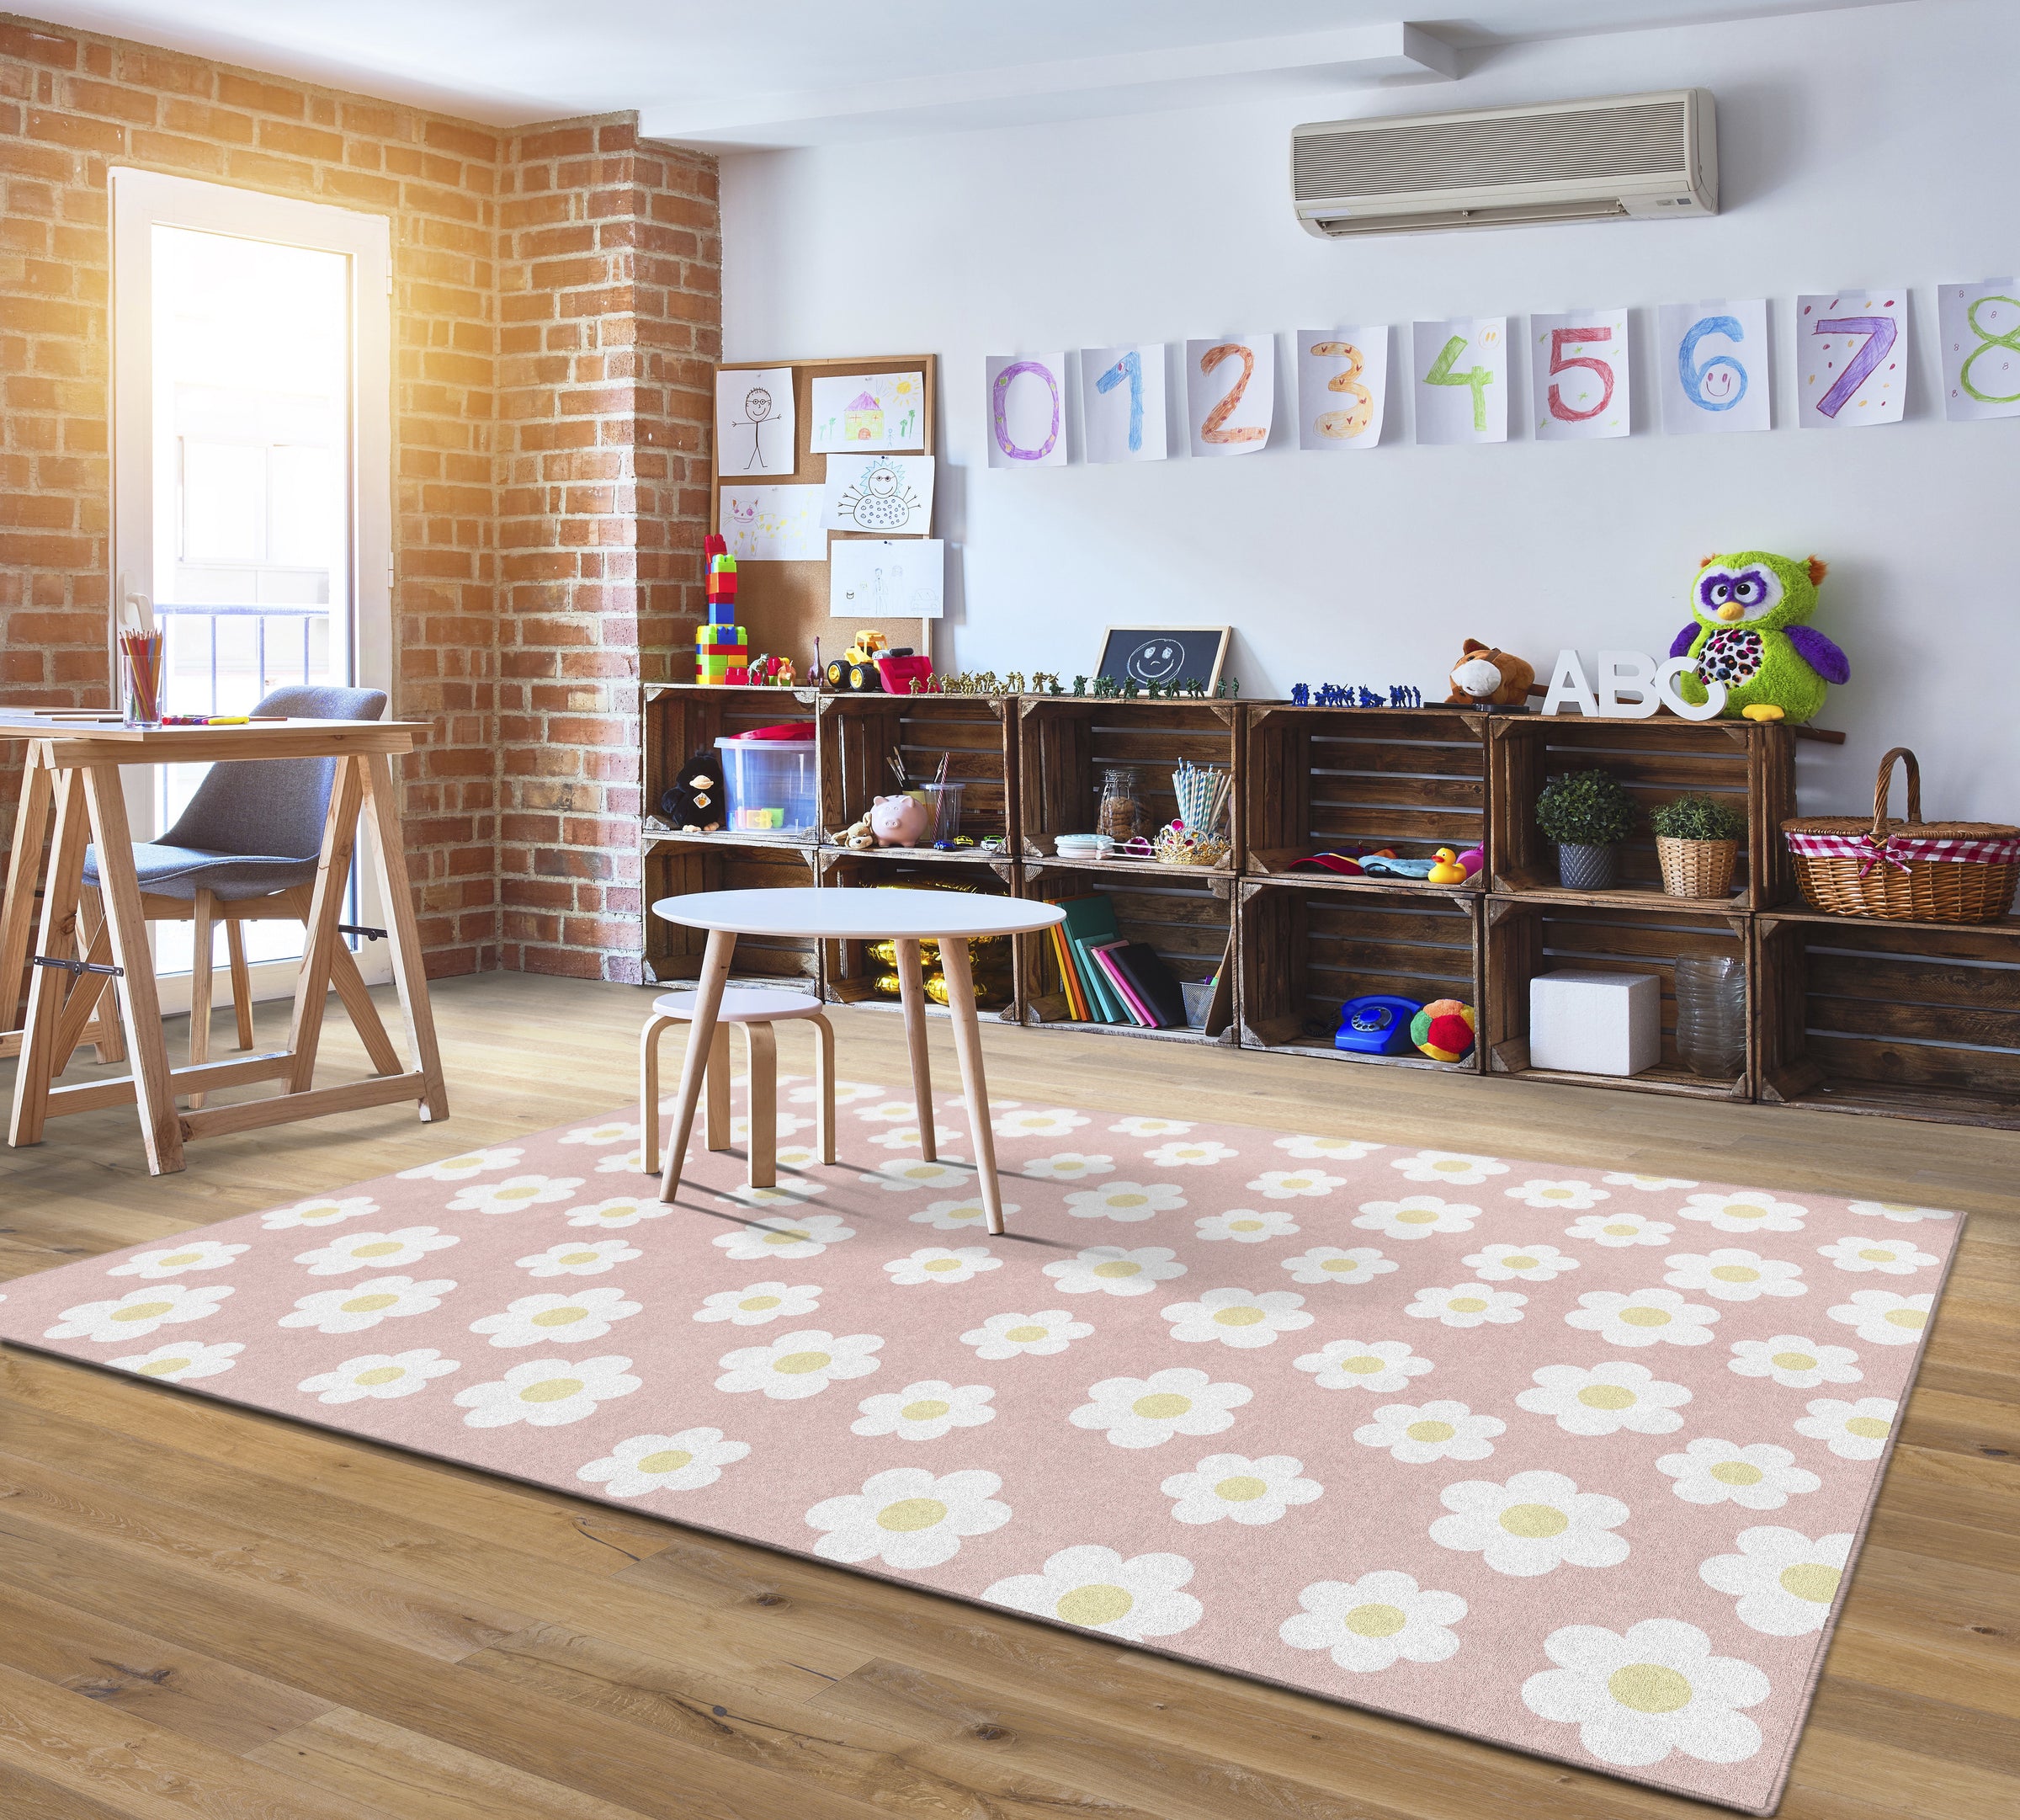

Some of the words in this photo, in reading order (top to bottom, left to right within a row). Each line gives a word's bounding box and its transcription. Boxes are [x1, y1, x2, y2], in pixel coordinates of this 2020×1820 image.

[1200, 343, 1267, 444] 2
[1310, 341, 1374, 439] 3
[1422, 335, 1493, 431] 4
[1548, 327, 1614, 423] 5
[1678, 316, 1748, 411] 6
[1812, 317, 1897, 418] 7
[1960, 295, 2020, 404] 8
[993, 361, 1059, 460] 0
[1095, 351, 1144, 452] 1
[1541, 649, 1728, 721] ABC
